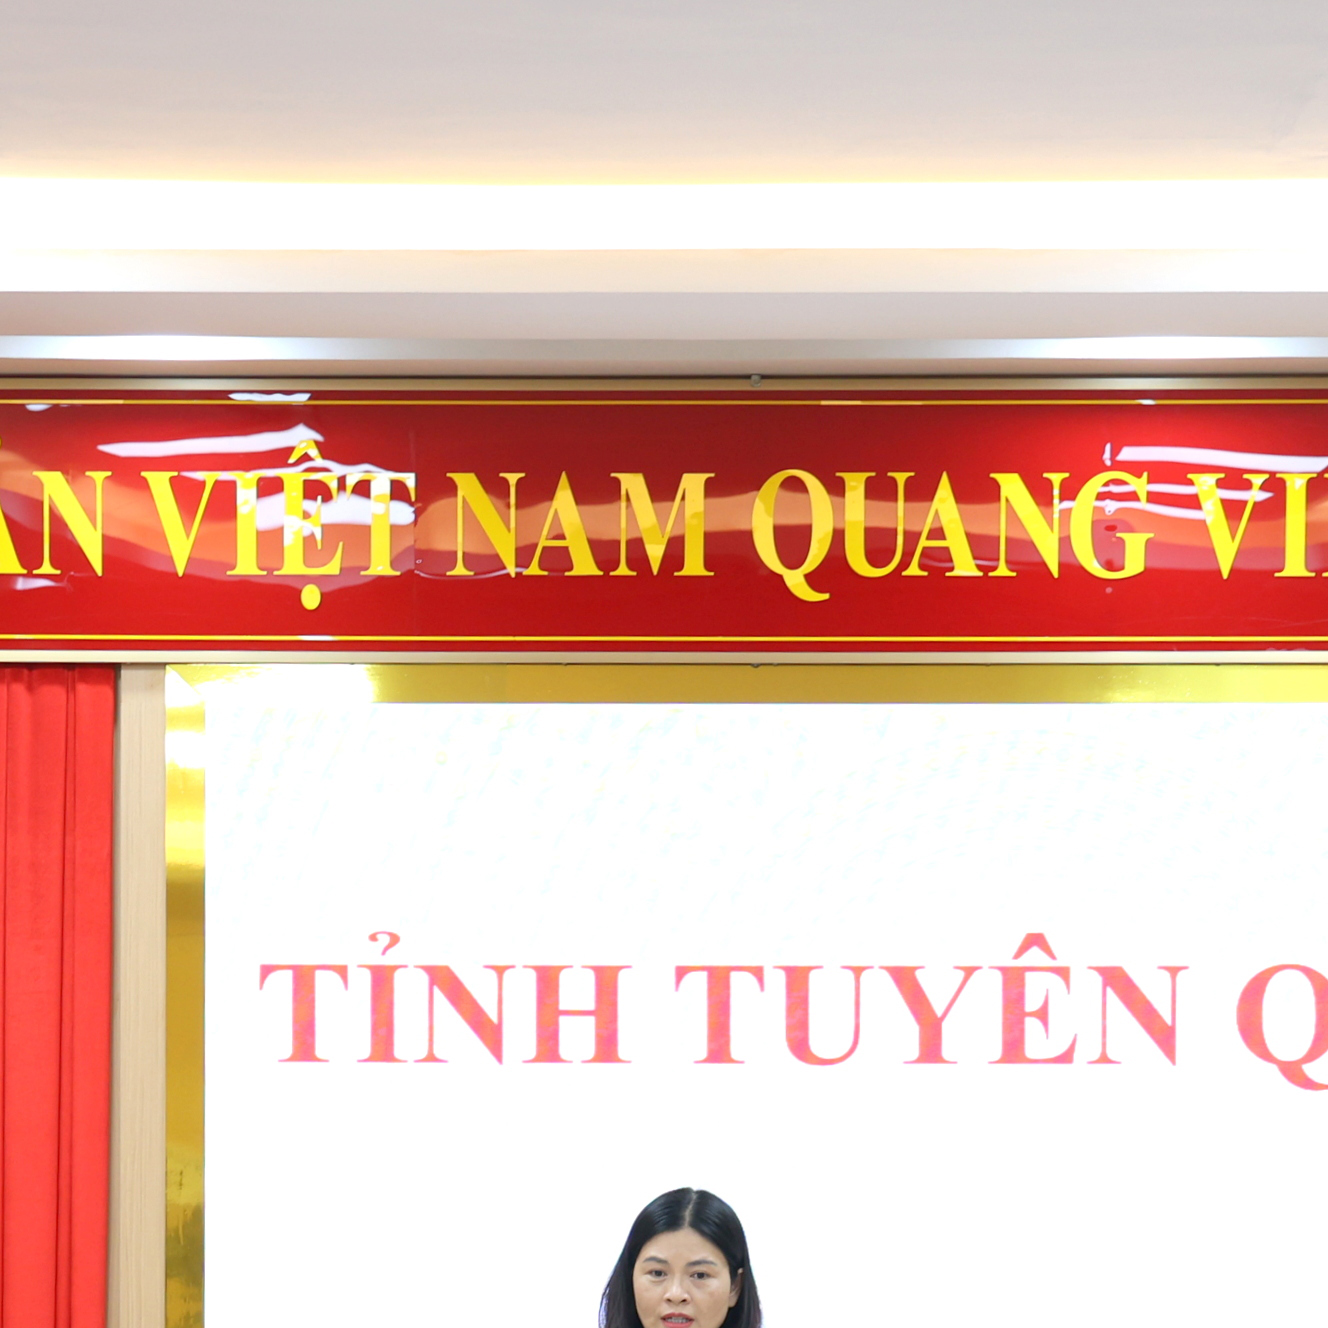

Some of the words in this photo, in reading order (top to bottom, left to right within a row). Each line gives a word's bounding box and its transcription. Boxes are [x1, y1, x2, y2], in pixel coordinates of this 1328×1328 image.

[140, 438, 417, 611] VIỆT
[440, 472, 714, 577] NAM
[750, 469, 1156, 602] QUANG
[259, 930, 633, 1066] TỈNH
[674, 932, 1190, 1067] TUYÊN
